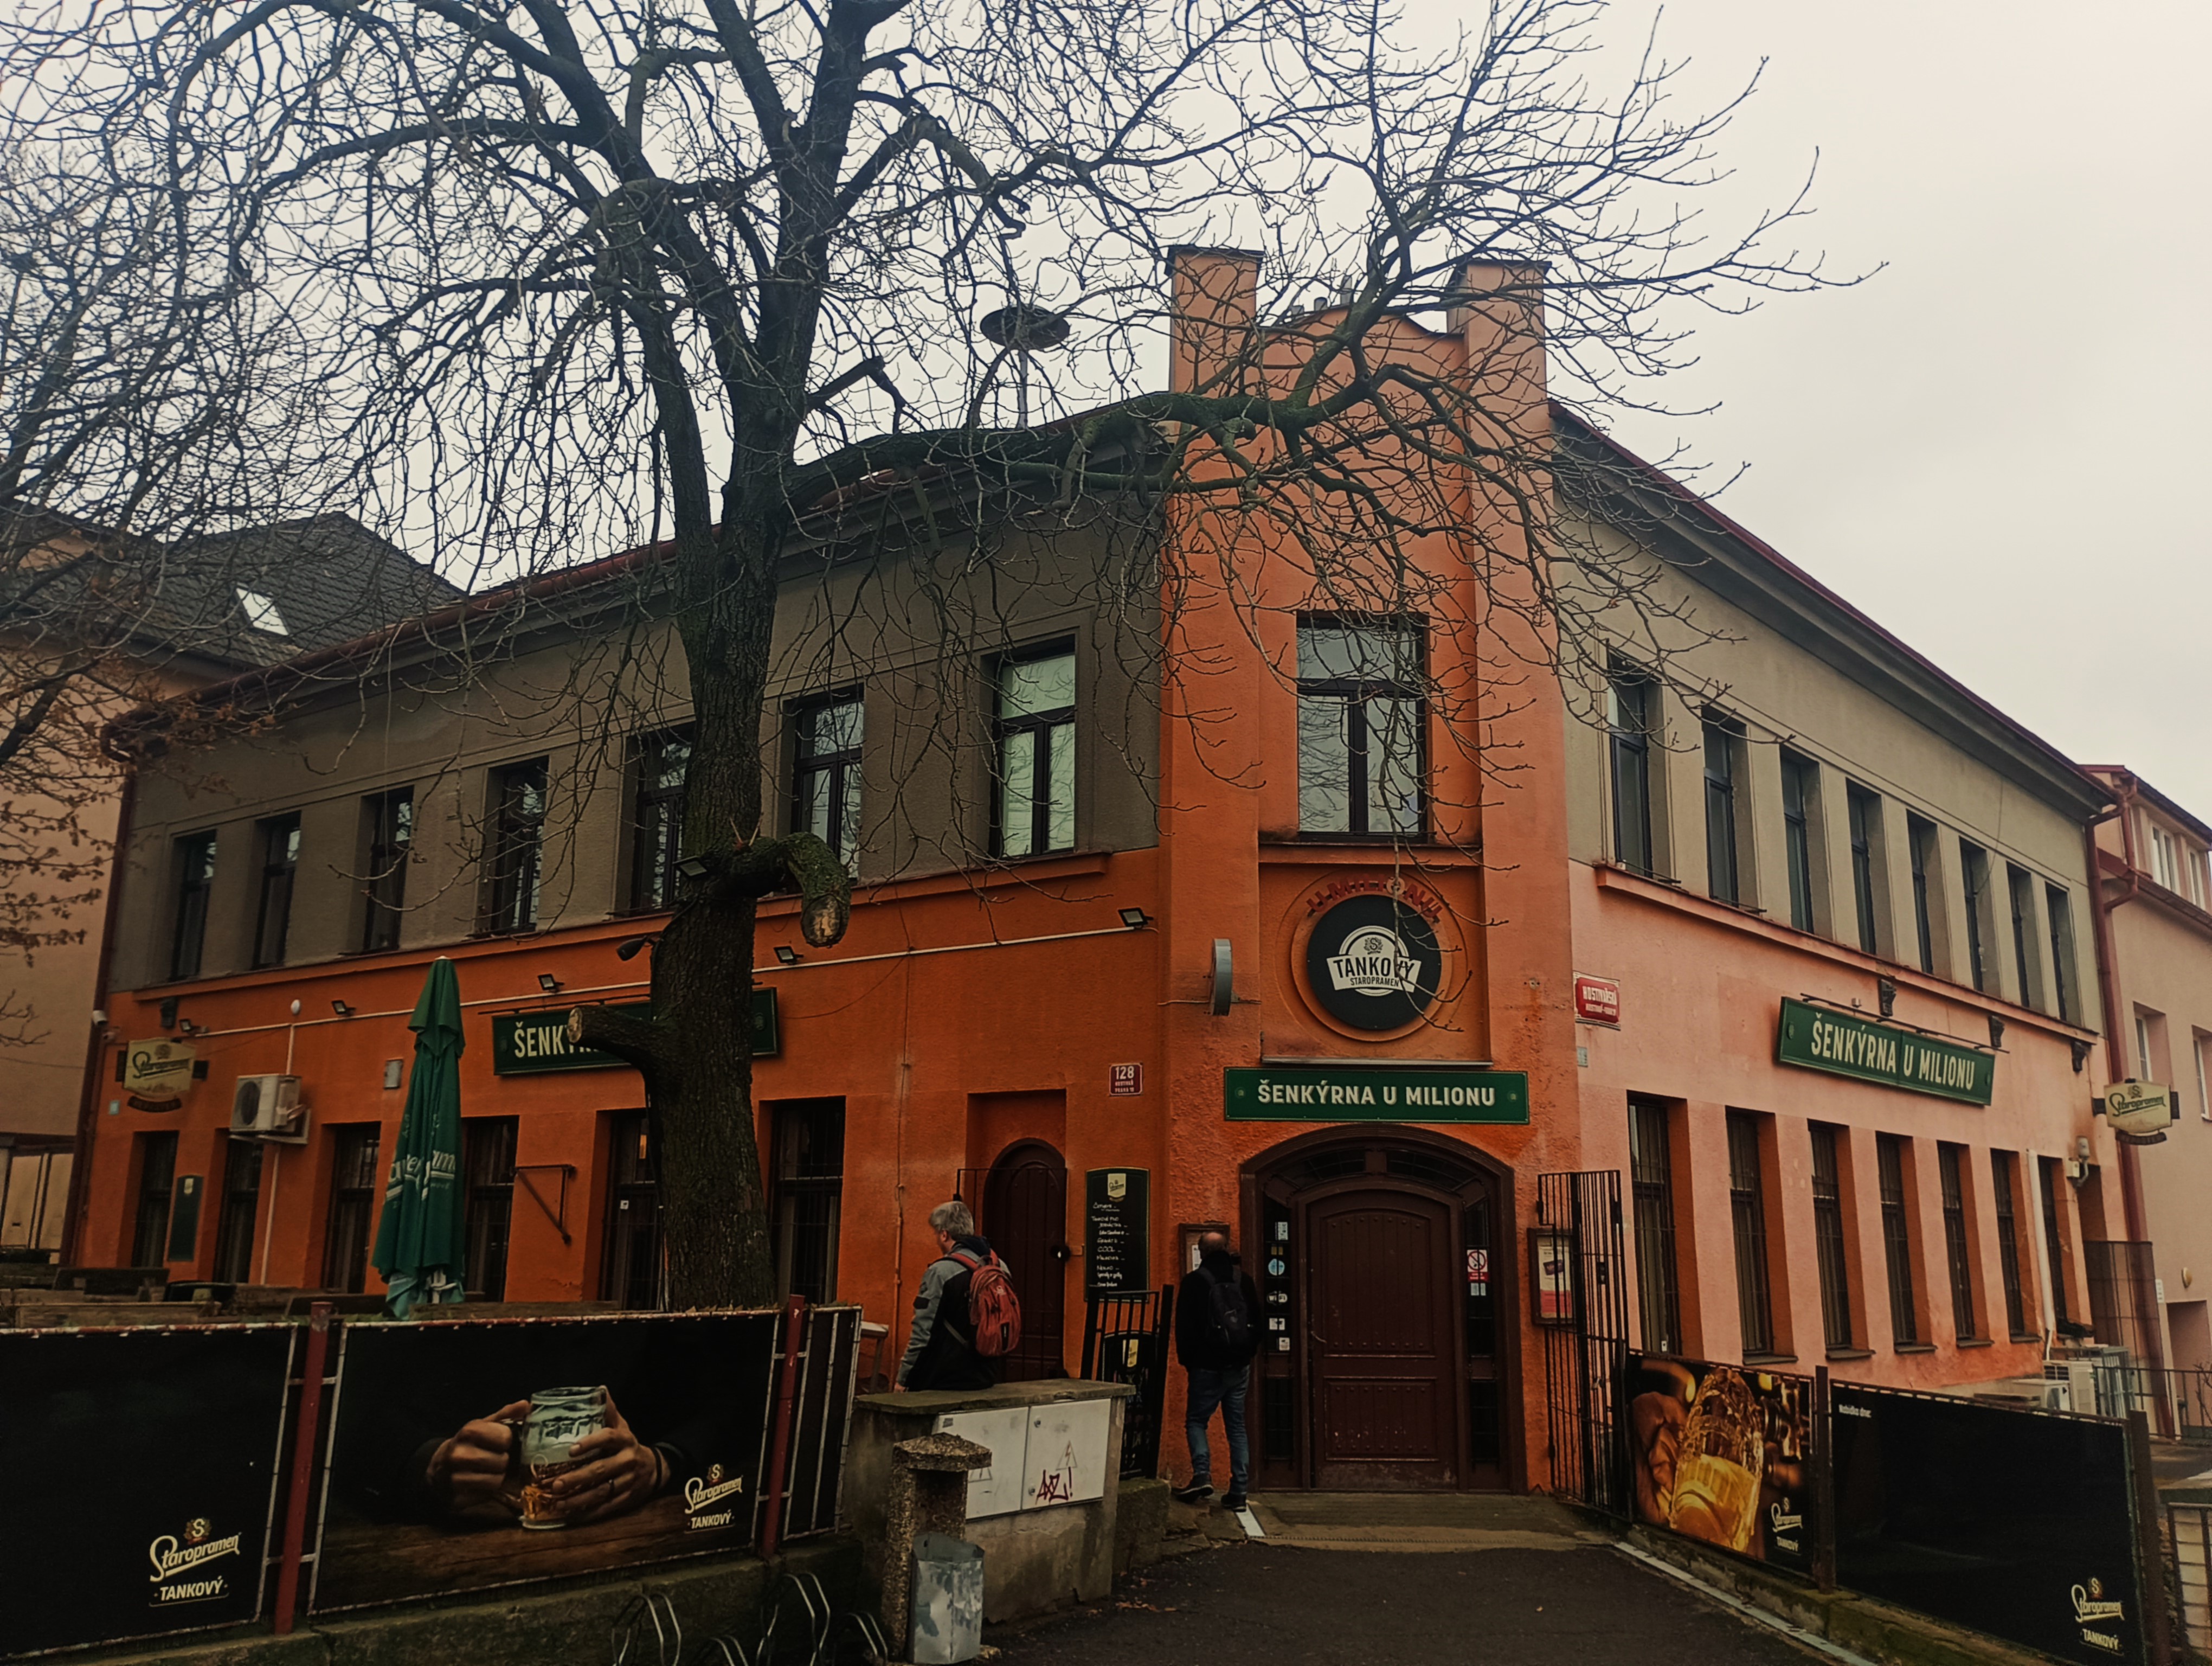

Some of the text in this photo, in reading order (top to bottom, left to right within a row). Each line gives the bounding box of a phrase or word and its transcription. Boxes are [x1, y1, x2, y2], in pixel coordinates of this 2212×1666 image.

[1350, 977, 1399, 987] STAROPRAMEN
[515, 1021, 600, 1058] ŠENK
[1811, 1012, 1975, 1090] ŠENKÝRNA U MILIONU
[1115, 1066, 1134, 1080] 128
[1258, 1079, 1495, 1106] ŠENKÝRNA U MILIONU
[685, 1477, 743, 1514] Staropramen
[691, 1509, 732, 1529] TANKOVÝ
[150, 1535, 240, 1582] Staropramen
[160, 1575, 223, 1601] TANKOVÝ
[2082, 1628, 2119, 1650] TANKOVÝ
